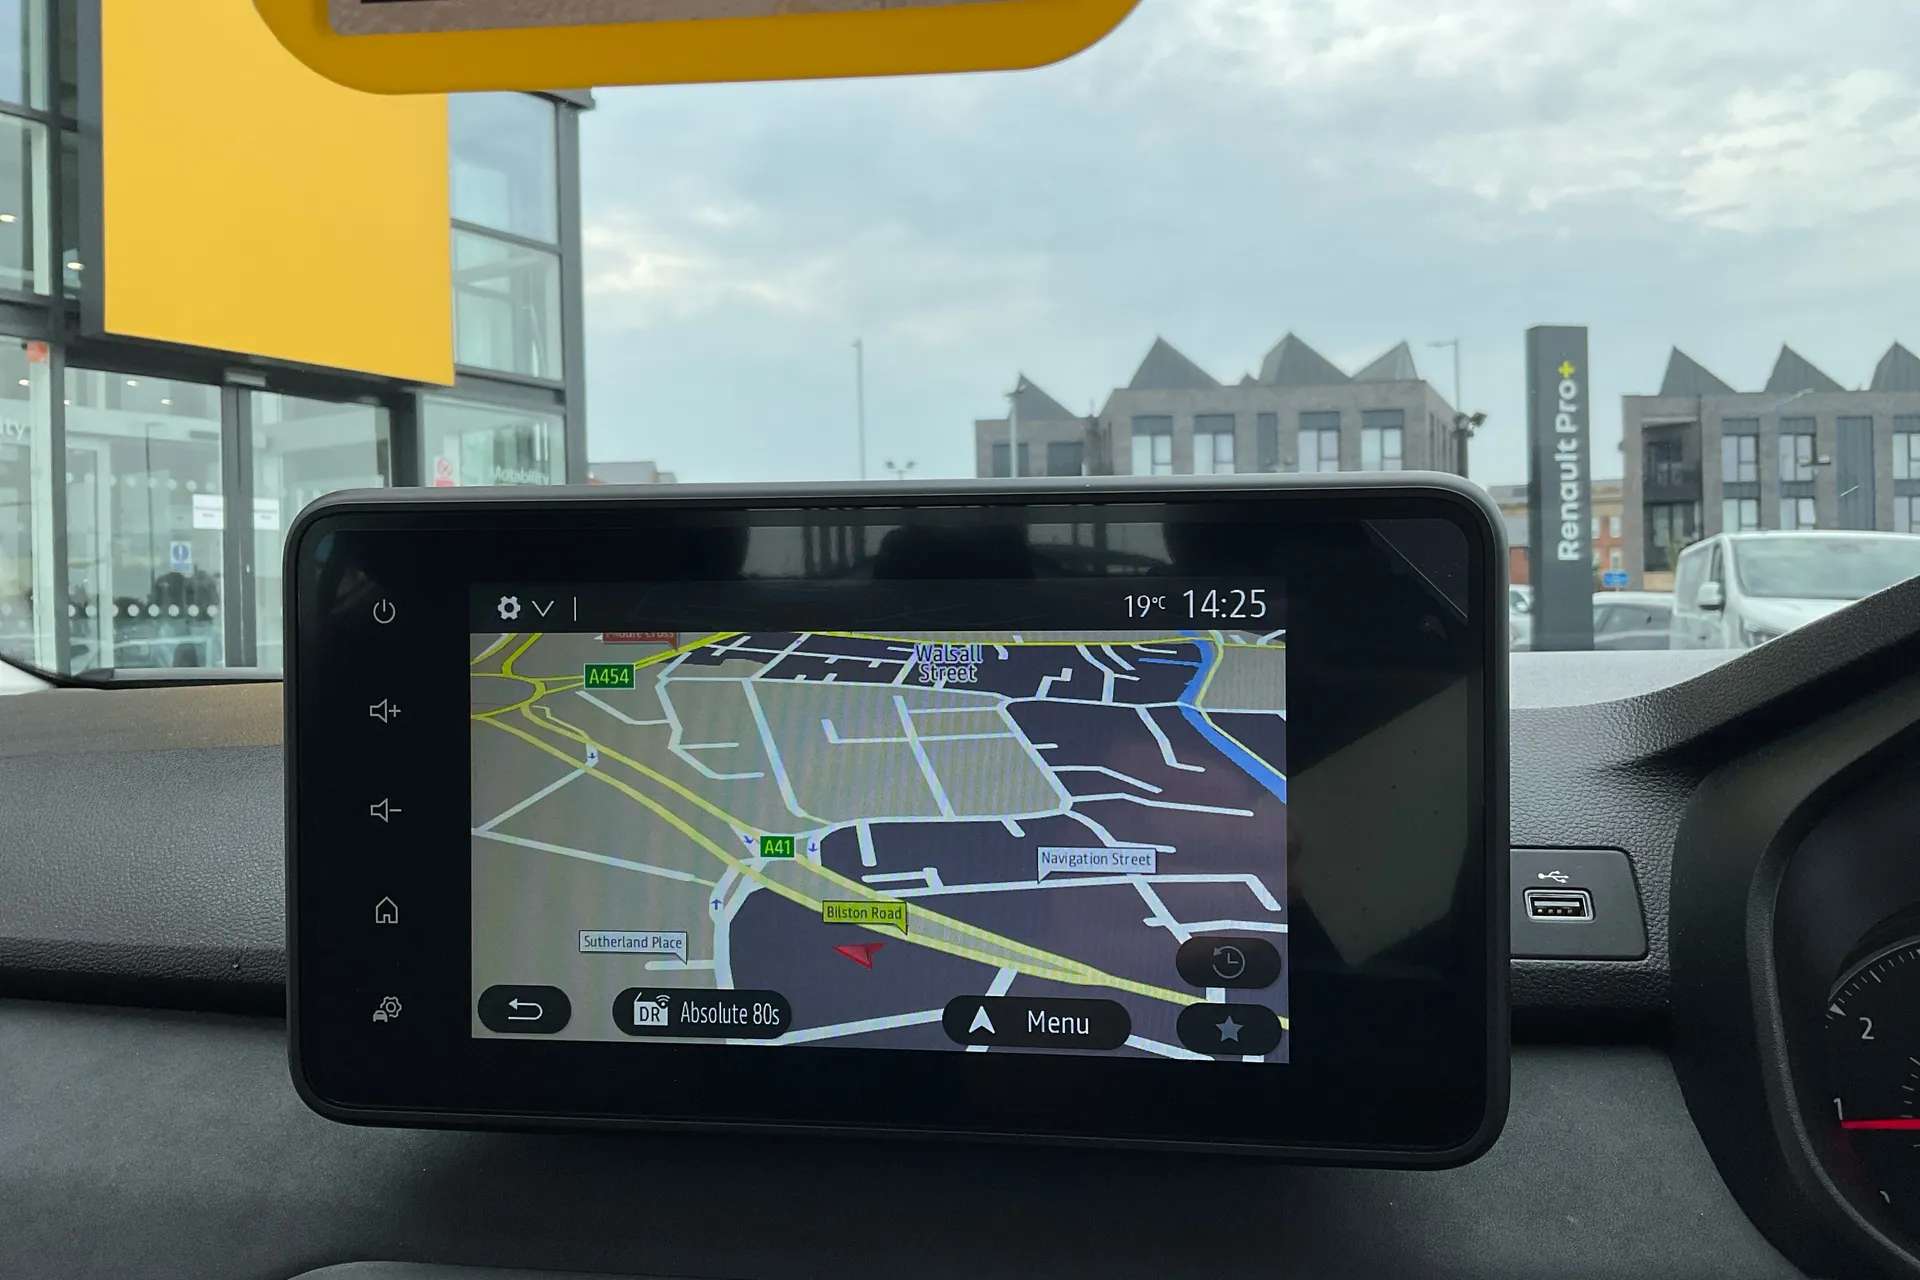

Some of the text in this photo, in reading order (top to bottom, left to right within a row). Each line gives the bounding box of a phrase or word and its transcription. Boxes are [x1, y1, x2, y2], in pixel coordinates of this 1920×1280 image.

[1555, 437, 1580, 561] Renault
[1183, 589, 1267, 619] 14:25
[914, 642, 984, 663] Walsall
[588, 667, 630, 685] A454
[919, 663, 978, 682] Street
[764, 839, 791, 855] A41
[1041, 851, 1152, 867] Navigation Street
[826, 905, 902, 920] Bilston Road
[583, 935, 682, 949] Sutherland Place
[639, 1006, 660, 1022] DR
[680, 1001, 780, 1026] Absolute 80s
[1027, 1009, 1090, 1035] Menu
[1858, 1016, 1876, 1040] 2
[1833, 1097, 1844, 1121] 1
